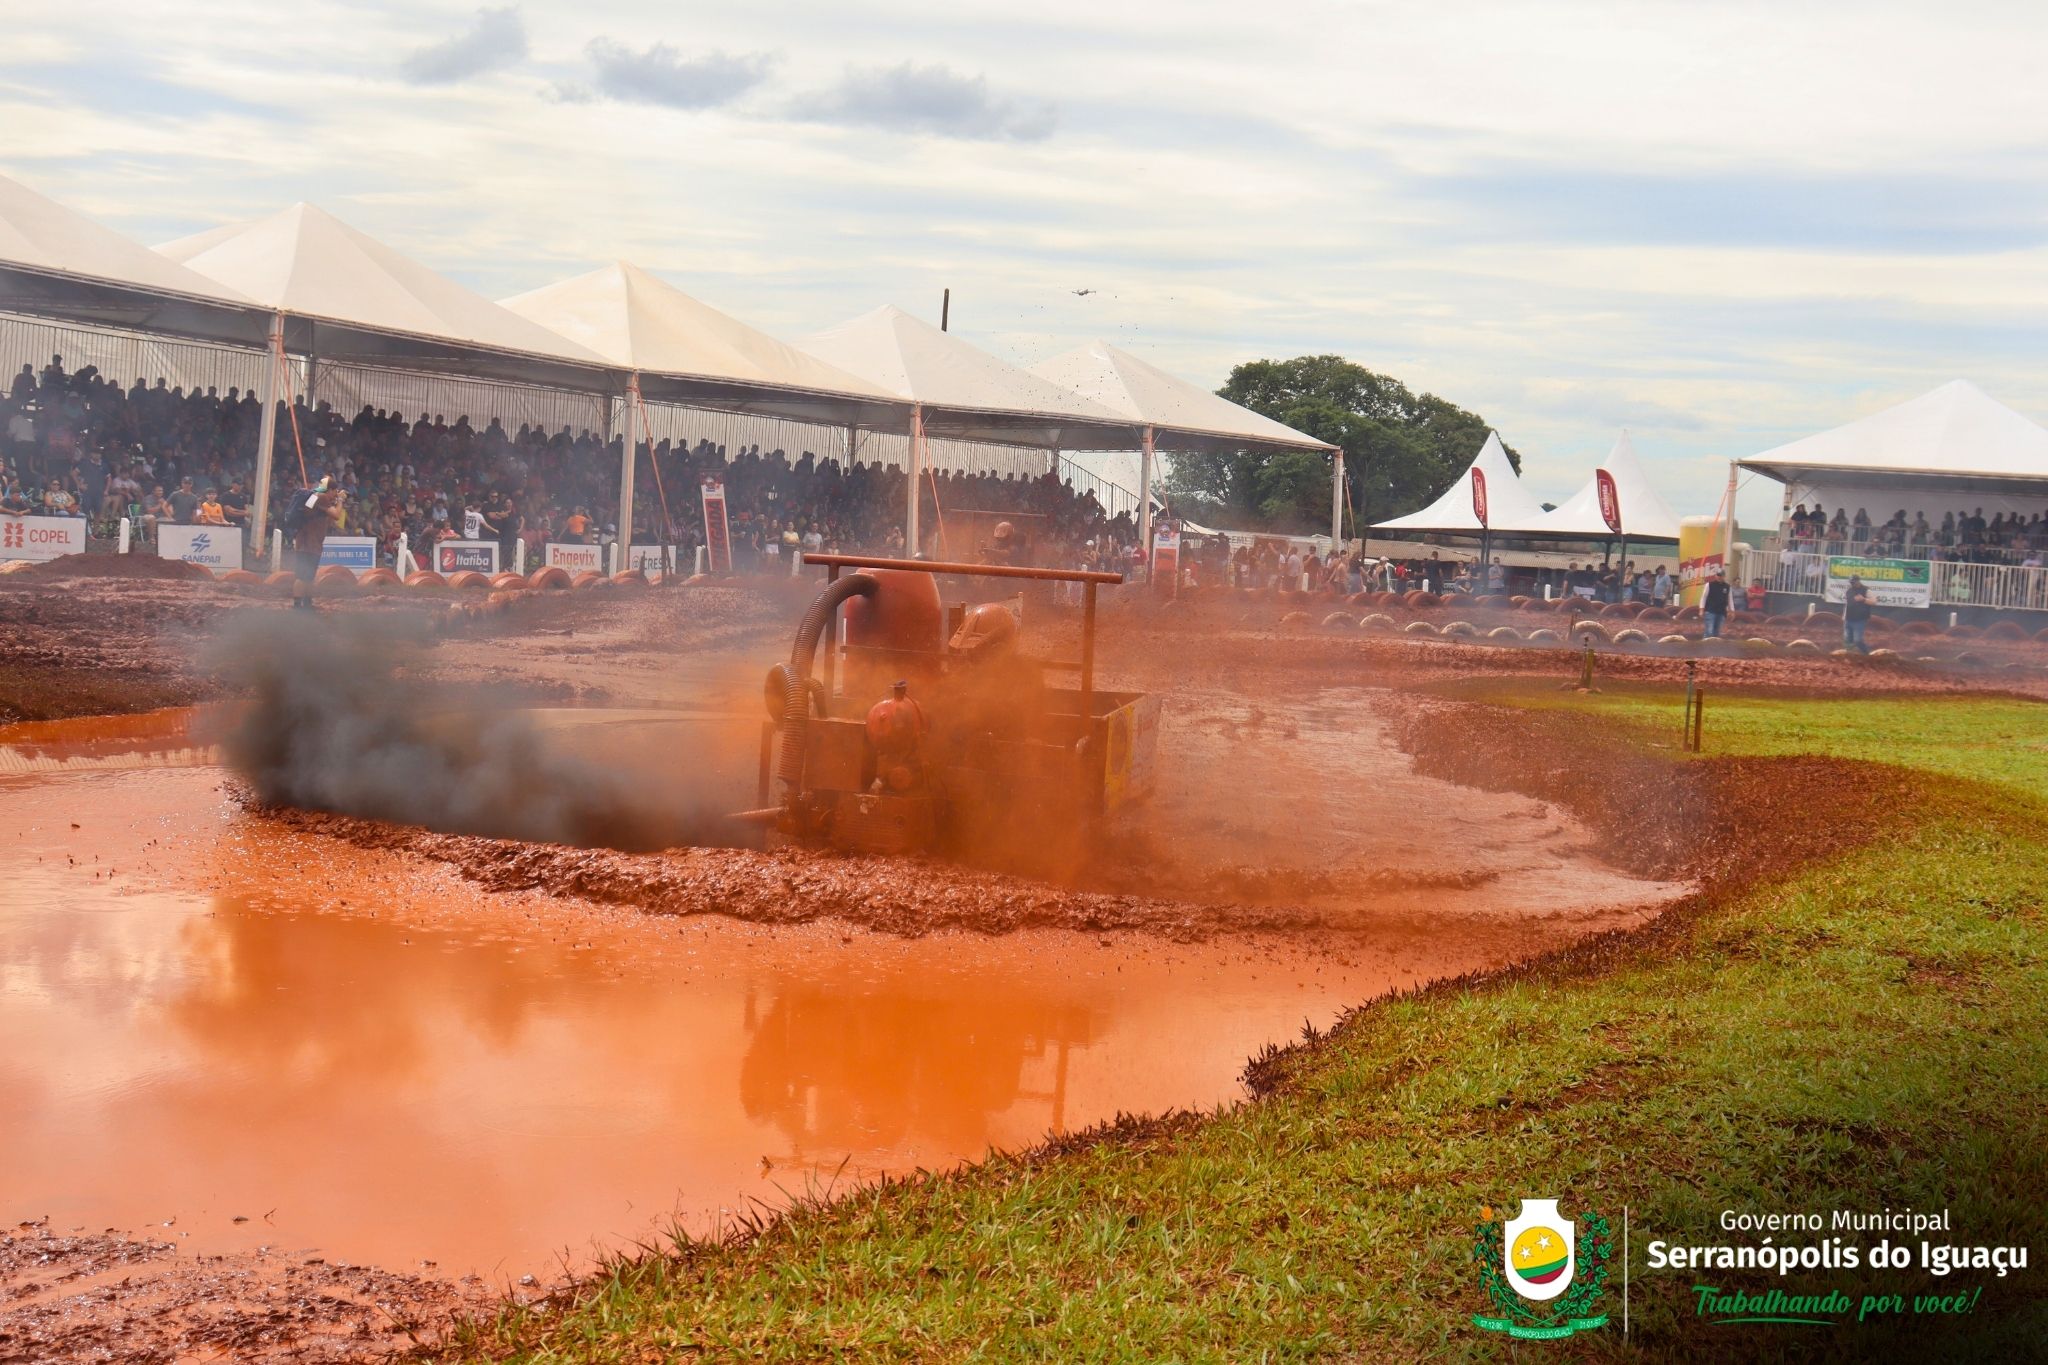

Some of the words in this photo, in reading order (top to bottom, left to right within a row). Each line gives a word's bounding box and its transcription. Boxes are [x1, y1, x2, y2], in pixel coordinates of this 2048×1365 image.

[466, 518, 477, 530] 20
[30, 529, 71, 544] COPEL
[182, 554, 222, 564] SANEPAR
[456, 554, 489, 566] Itatiba
[552, 547, 595, 569] Engevix
